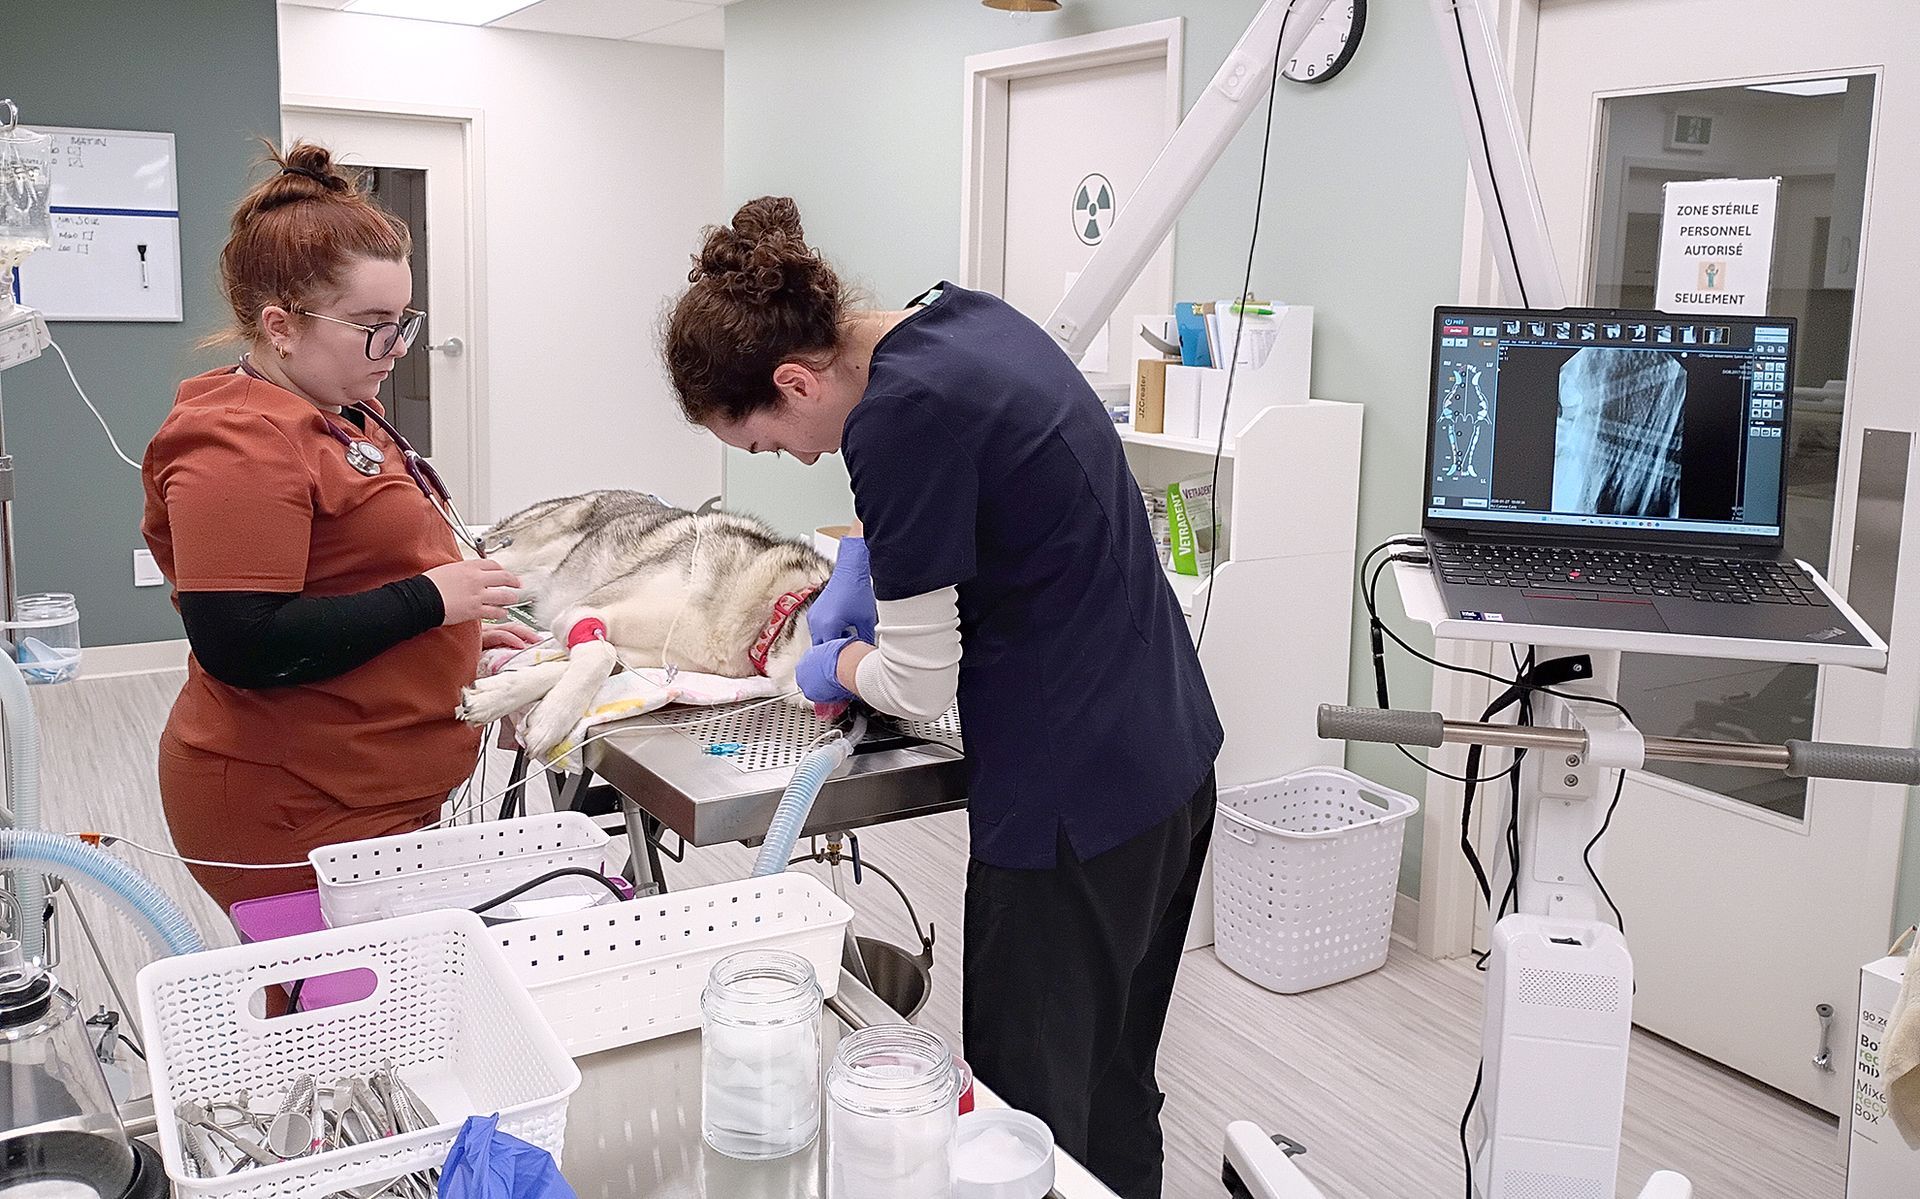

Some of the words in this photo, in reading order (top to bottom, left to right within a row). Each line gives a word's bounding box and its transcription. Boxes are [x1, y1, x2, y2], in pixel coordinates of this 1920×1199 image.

[1290, 59, 1298, 72] 7
[1326, 53, 1334, 67] 5
[1307, 64, 1315, 77] 6
[70, 136, 107, 147] MATIN
[1677, 205, 1709, 216] ZONE
[1711, 202, 1759, 216] STÉRILE
[1680, 226, 1752, 237] PERSONNEL
[1684, 243, 1743, 256] AUTORISÉ
[1675, 292, 1745, 305] SEULEMENT
[1182, 484, 1212, 500] VETRADENT
[1170, 491, 1192, 556] VETRADENT
[1862, 1010, 1876, 1021] go
[1860, 1034, 1881, 1052] Bo
[1854, 1103, 1879, 1125] Box
